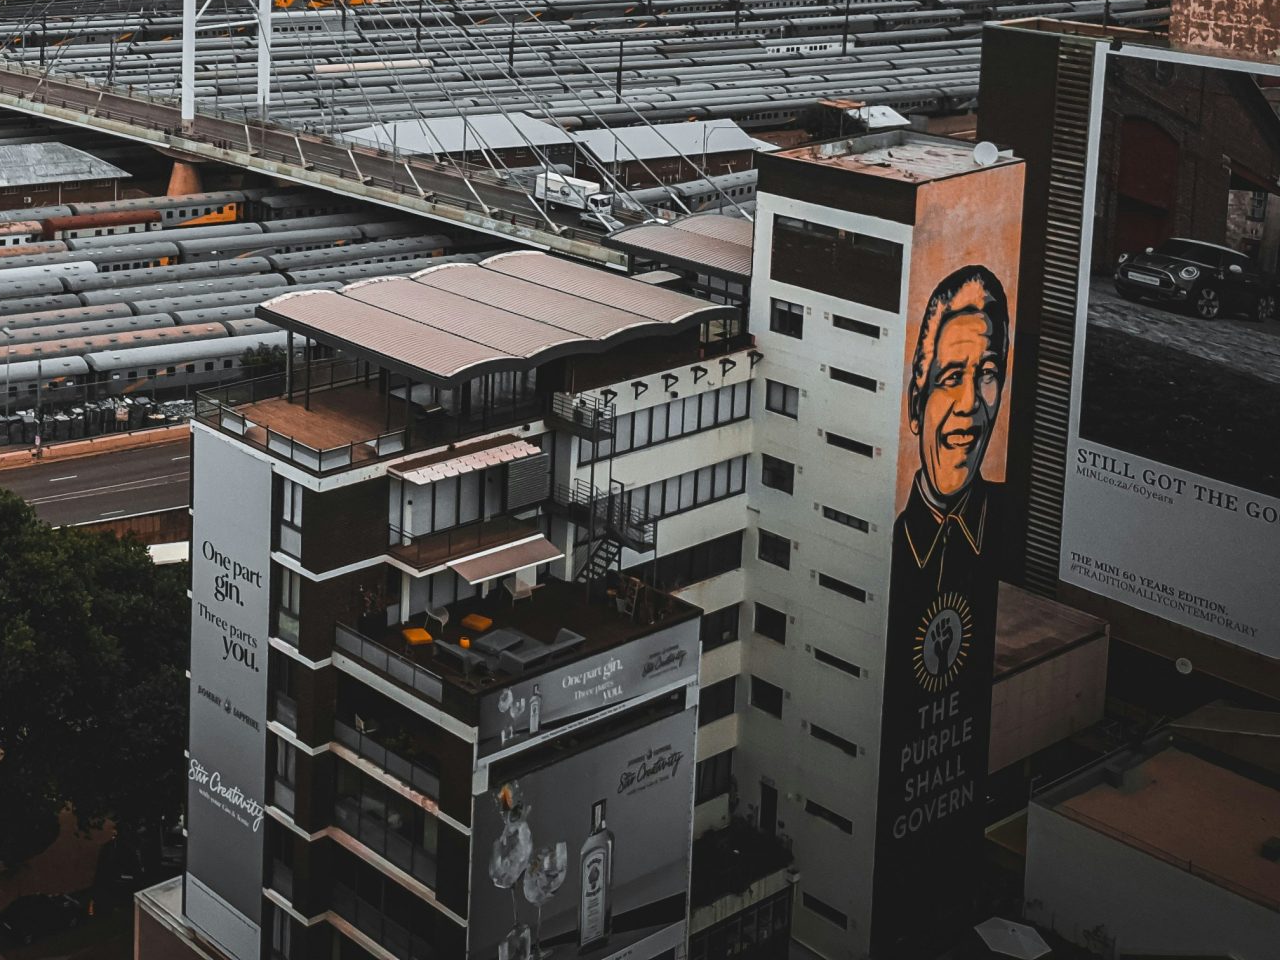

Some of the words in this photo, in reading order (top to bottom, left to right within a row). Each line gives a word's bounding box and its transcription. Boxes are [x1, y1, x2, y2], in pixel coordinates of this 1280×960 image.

[1077, 448, 1135, 480] STILL
[1142, 469, 1186, 495] GOT
[1194, 484, 1238, 512] THE
[1246, 501, 1280, 525] GO
[202, 540, 231, 570] One
[233, 560, 262, 588] part
[1071, 551, 1092, 567] THE
[1094, 560, 1119, 577] MINI
[1122, 570, 1137, 582] 60
[1139, 577, 1175, 596] YEARS
[1178, 591, 1228, 615] EDITION.
[214, 573, 244, 607] gin.
[1070, 562, 1258, 638] #TRADITIONALLYCONTEMPORARY
[198, 602, 228, 631] Three
[230, 625, 257, 649] parts
[222, 635, 259, 672] you.
[562, 674, 581, 688] One
[918, 691, 960, 729] THE
[900, 717, 973, 772] PURPLE
[188, 759, 209, 785] Stir
[209, 771, 264, 832] Creativity
[904, 755, 966, 802] SHALL
[893, 781, 974, 839] GOVERN
